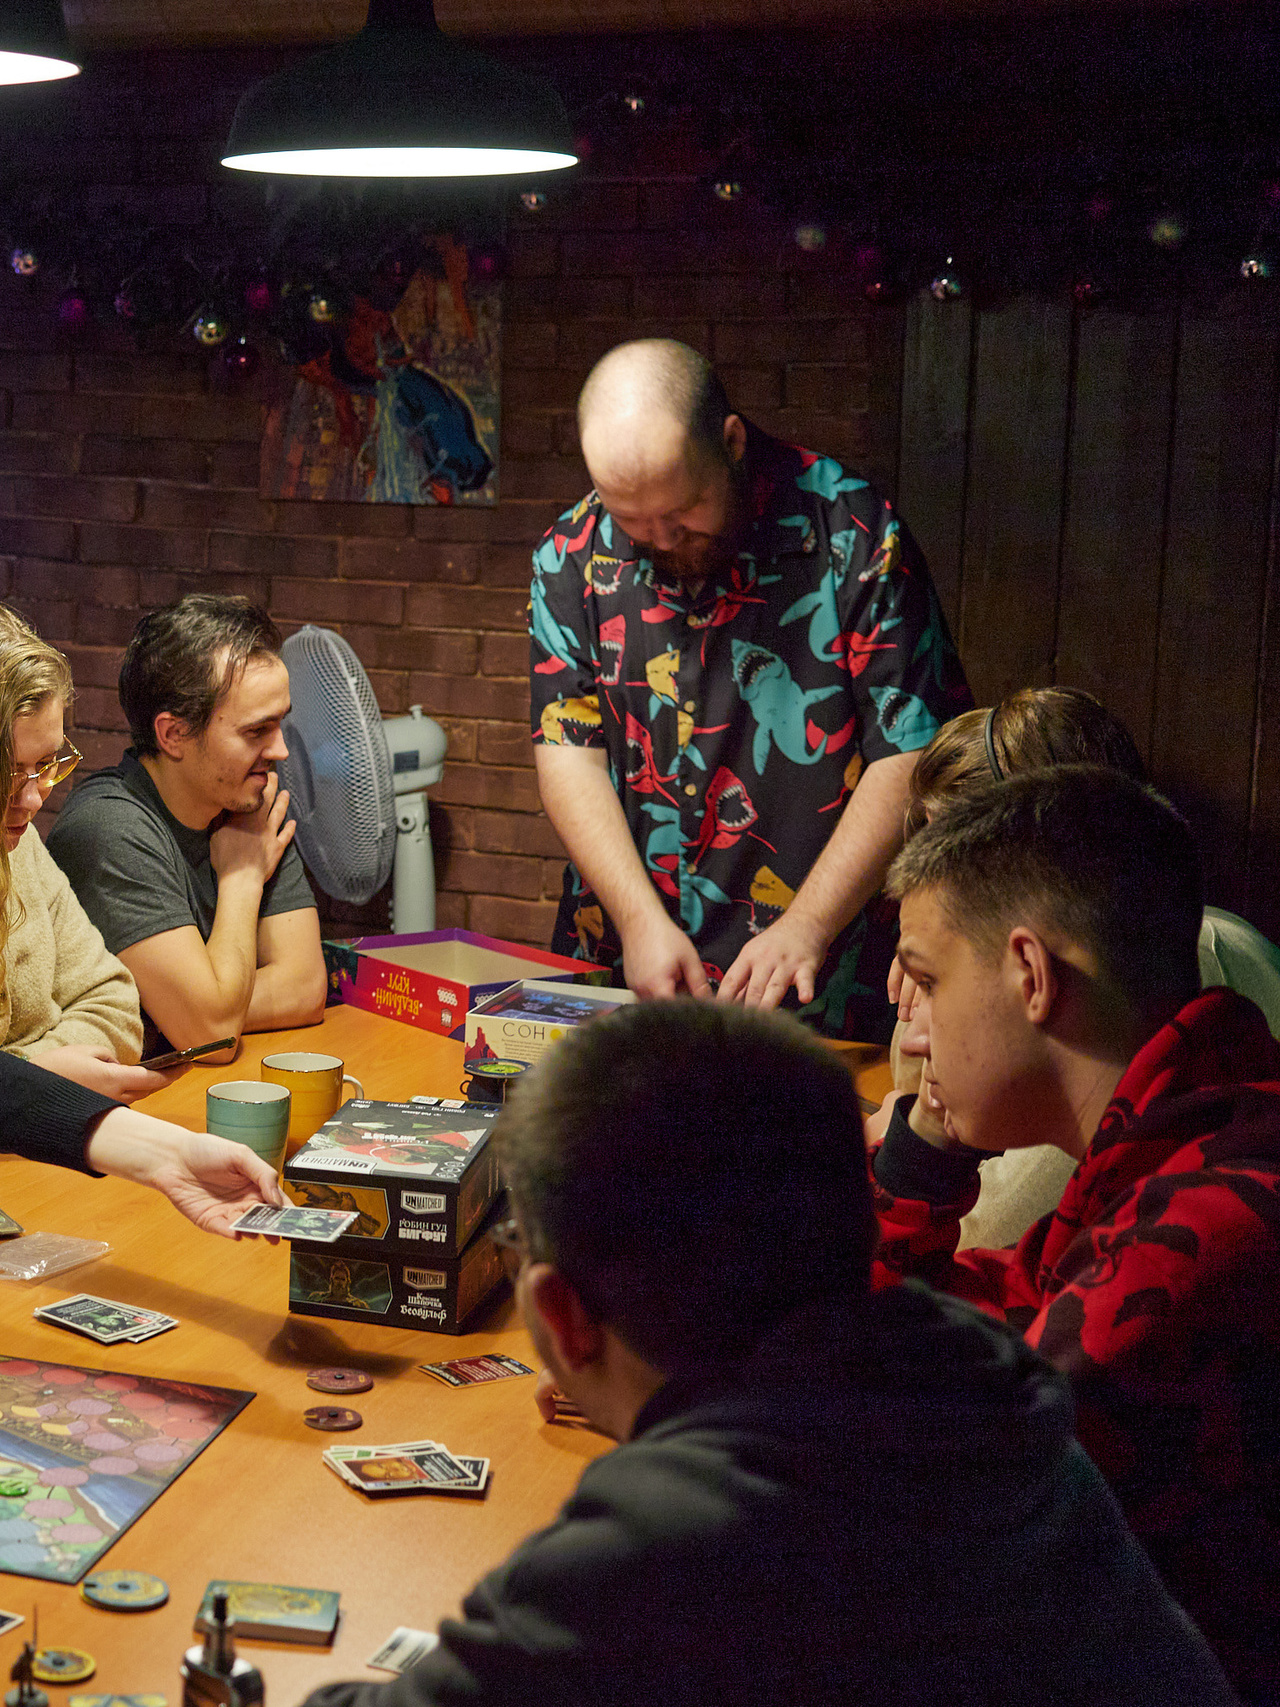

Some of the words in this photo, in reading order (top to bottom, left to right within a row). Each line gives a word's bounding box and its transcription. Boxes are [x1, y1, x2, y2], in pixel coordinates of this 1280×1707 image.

[387, 972, 410, 995] КРУГ
[376, 987, 419, 1016] ВЕДЬМИН
[301, 1156, 369, 1169] UNMATCHED
[405, 1195, 442, 1210] UNMATCHED
[399, 1219, 429, 1230] РОБИН
[431, 1222, 447, 1232] ГУД
[398, 1227, 447, 1243] БИГФУТ
[407, 1270, 443, 1286] UNMATCHED
